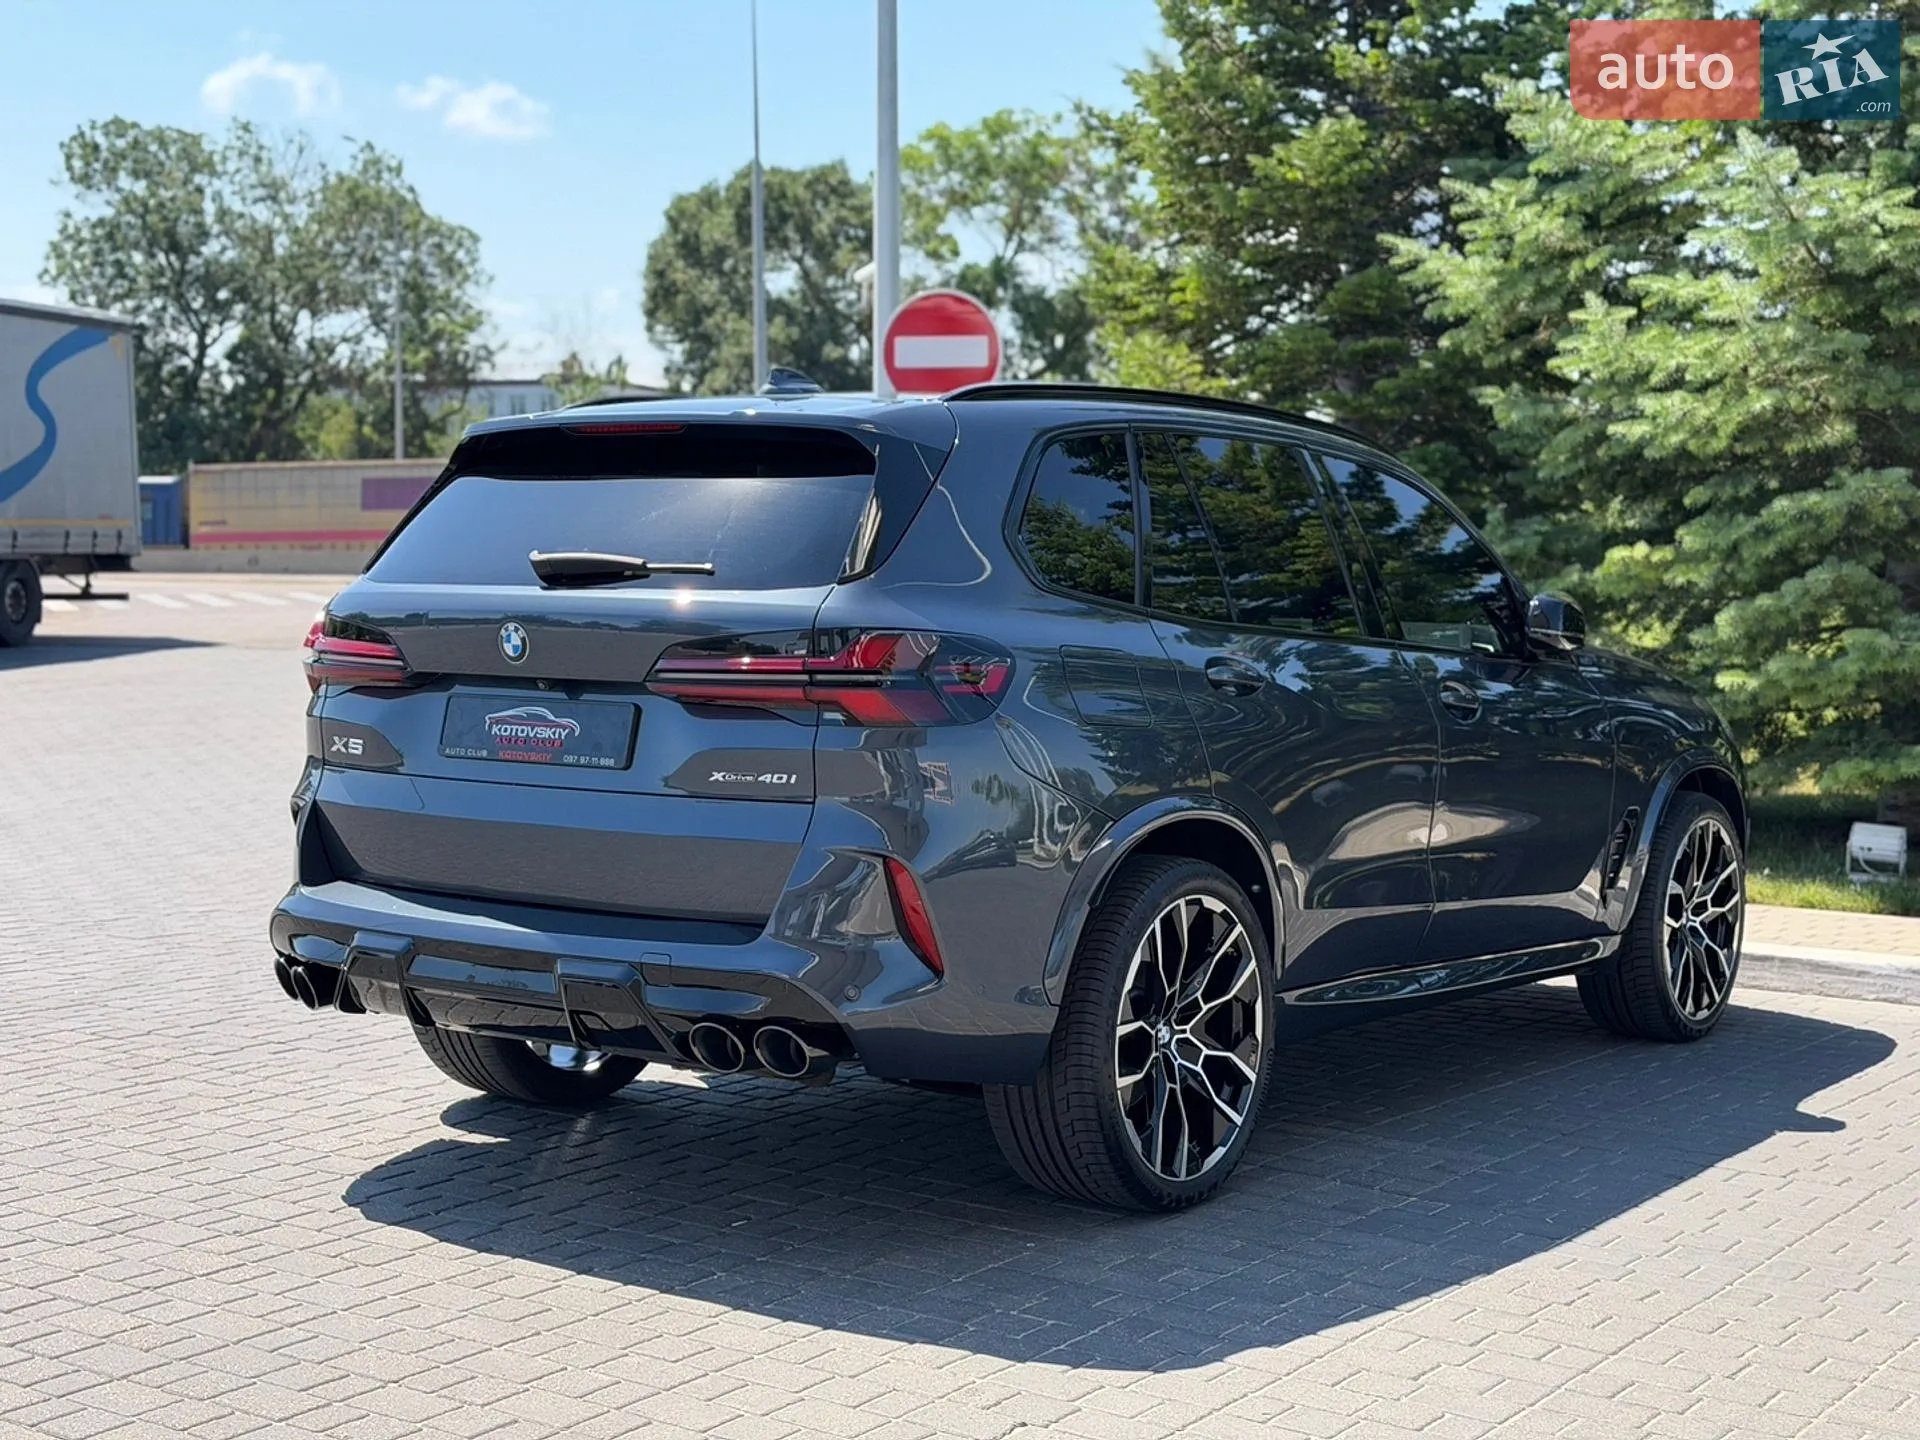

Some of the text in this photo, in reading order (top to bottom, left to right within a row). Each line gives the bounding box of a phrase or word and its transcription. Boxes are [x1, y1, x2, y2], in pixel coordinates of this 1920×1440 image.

[491, 724, 569, 740] KOTOVSKIY
[330, 735, 363, 756] X5
[496, 737, 563, 748] AUTO CLUB
[444, 747, 466, 756] AUTO
[467, 748, 488, 757] CLUB
